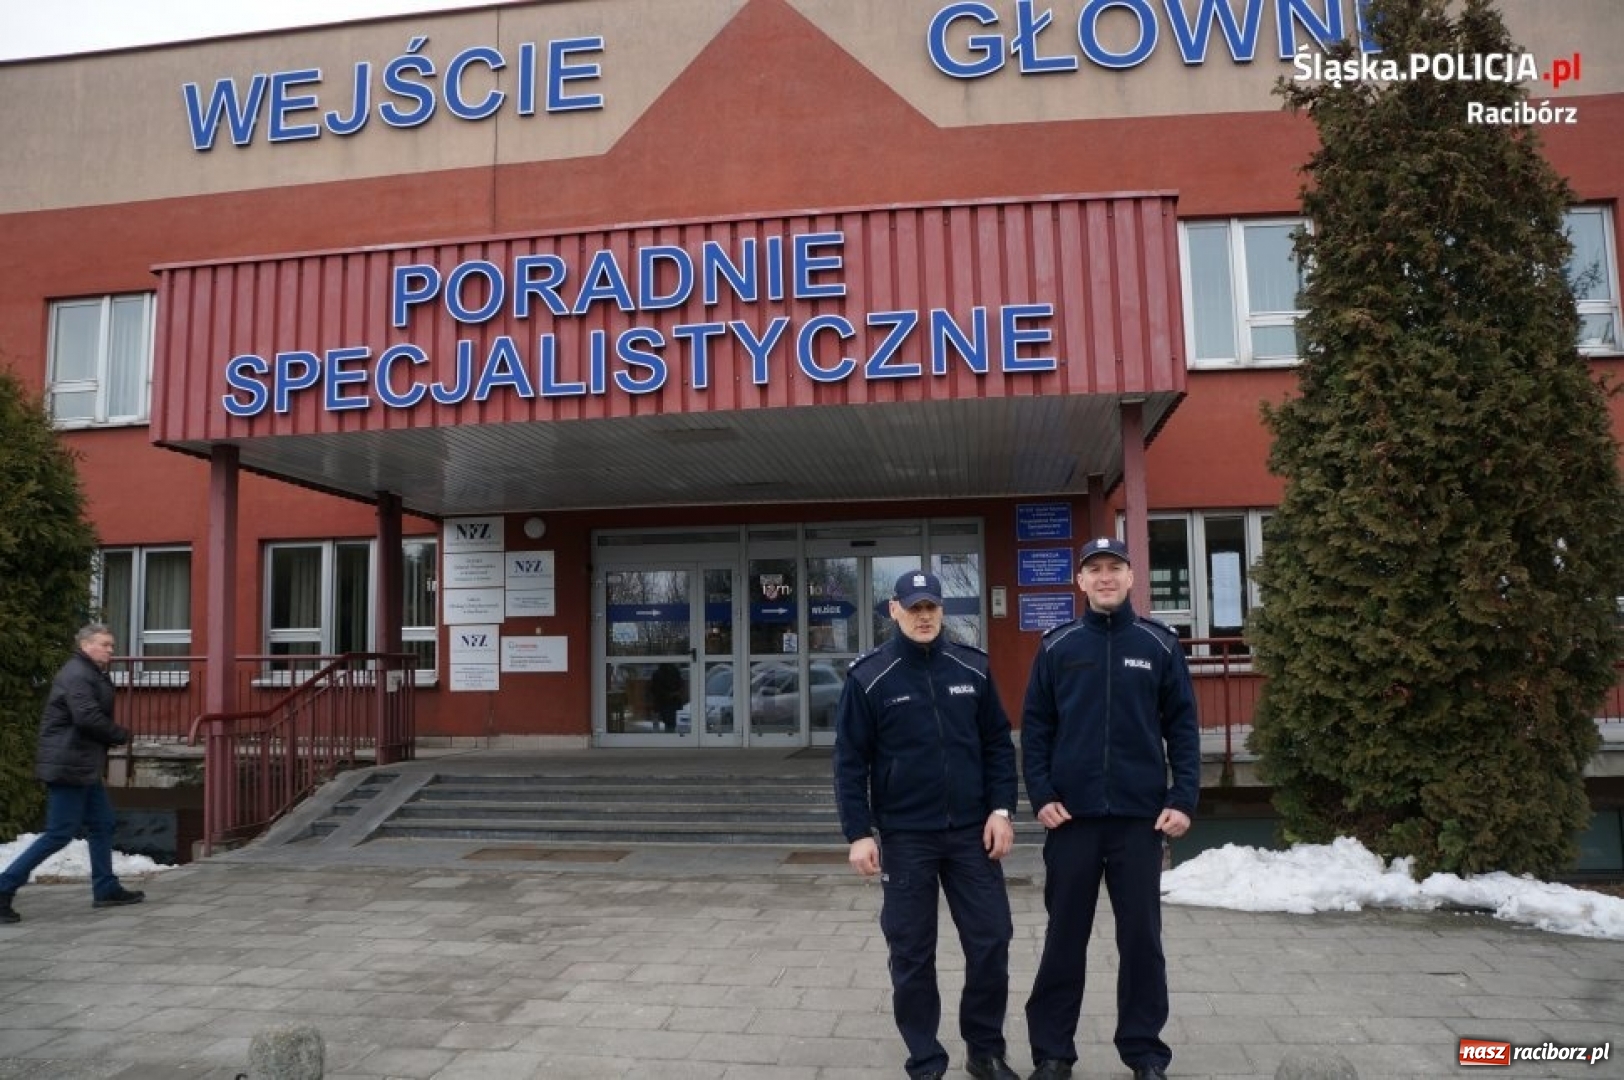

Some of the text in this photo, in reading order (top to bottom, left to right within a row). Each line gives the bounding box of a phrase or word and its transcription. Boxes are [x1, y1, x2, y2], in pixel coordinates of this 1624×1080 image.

[183, 36, 604, 150] WEJŚCIE
[392, 231, 847, 328] PORADNIE
[223, 302, 1058, 417] SPECJALISTYCZNE
[456, 523, 491, 540] NFZ
[514, 560, 543, 573] NFZ
[461, 634, 488, 647] NFZ
[1124, 658, 1152, 670] POLICJA
[948, 685, 975, 695] POLICJA
